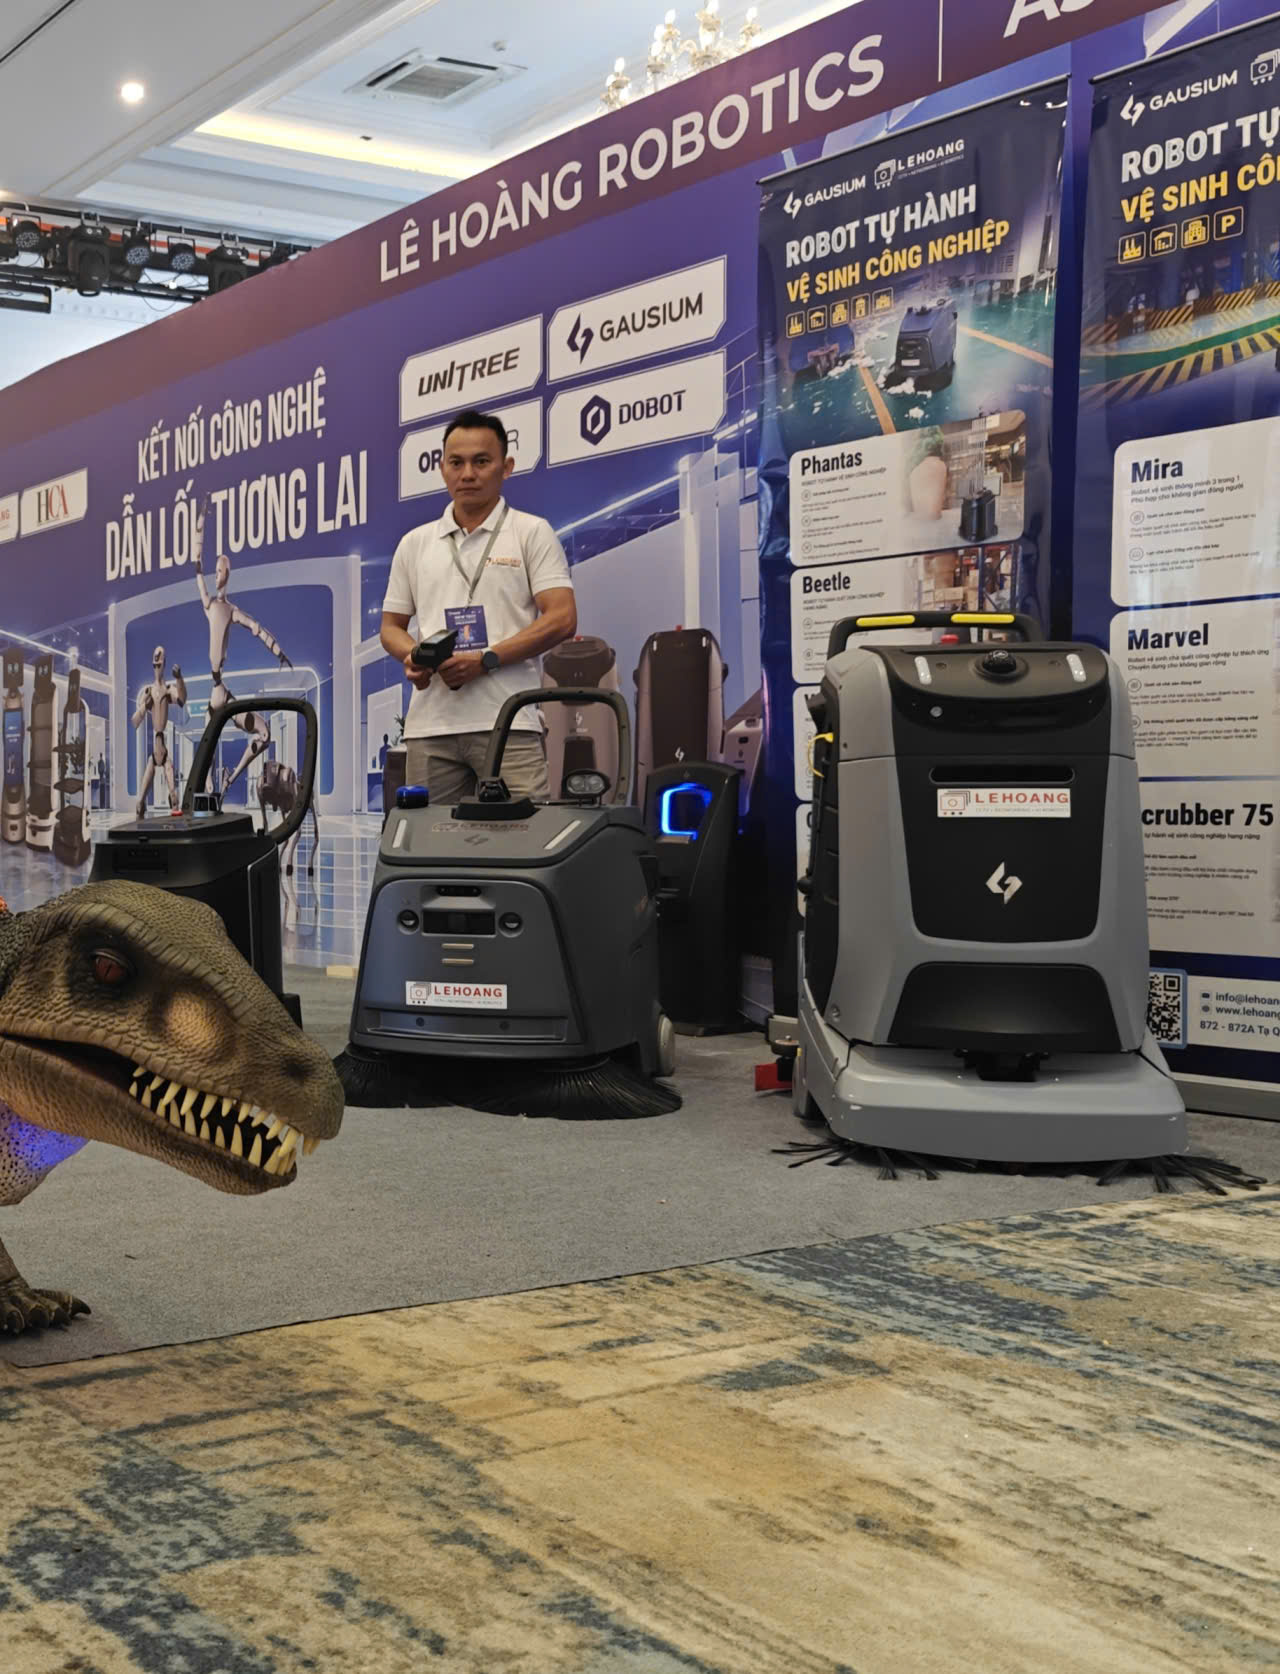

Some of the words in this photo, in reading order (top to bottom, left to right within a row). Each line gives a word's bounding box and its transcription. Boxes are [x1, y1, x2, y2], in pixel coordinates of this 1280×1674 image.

[1149, 70, 1238, 111] GAUSIUM
[379, 221, 420, 283] LÊ
[431, 161, 582, 262] HOÀNG
[598, 35, 885, 197] ROBOTICS
[898, 139, 965, 171] LEHOANG
[1121, 122, 1229, 184] ROBOT
[804, 176, 866, 207] GAUSIUM
[1121, 186, 1155, 223] VỆ
[1162, 170, 1228, 212] SINH
[1237, 152, 1280, 192] CÔ
[786, 220, 860, 268] ROBOT
[864, 206, 900, 244] TỰ
[904, 184, 977, 233] HÀNH
[1221, 214, 1236, 233] P
[786, 272, 810, 303] VỆ
[815, 261, 860, 295] SINH
[865, 245, 923, 281] CÔNG
[928, 219, 1010, 264] NGHIỆP
[599, 292, 703, 342] GAUSIUM
[418, 347, 520, 396] UNITREE
[138, 419, 170, 484] KẾT
[175, 404, 205, 473] NỐI
[210, 399, 262, 461] CÔNG
[267, 366, 327, 443] NGHỆ
[619, 390, 686, 425] DOBOT
[801, 451, 863, 476] Phantas
[1131, 458, 1183, 483] Mira
[37, 483, 69, 524] HCA
[106, 492, 152, 581] DẪN
[159, 479, 198, 570] LỐI
[211, 467, 307, 557] TƯƠNG
[317, 450, 367, 534] LAI
[802, 571, 851, 594] Beetle
[1128, 623, 1209, 651] Marvel
[975, 793, 1069, 803] LEHOANG
[1141, 802, 1235, 826] crubber
[1242, 803, 1274, 826] 75
[434, 985, 503, 998] LEHOANG
[1200, 1020, 1219, 1030] 872
[1228, 1023, 1255, 1033] 872A
